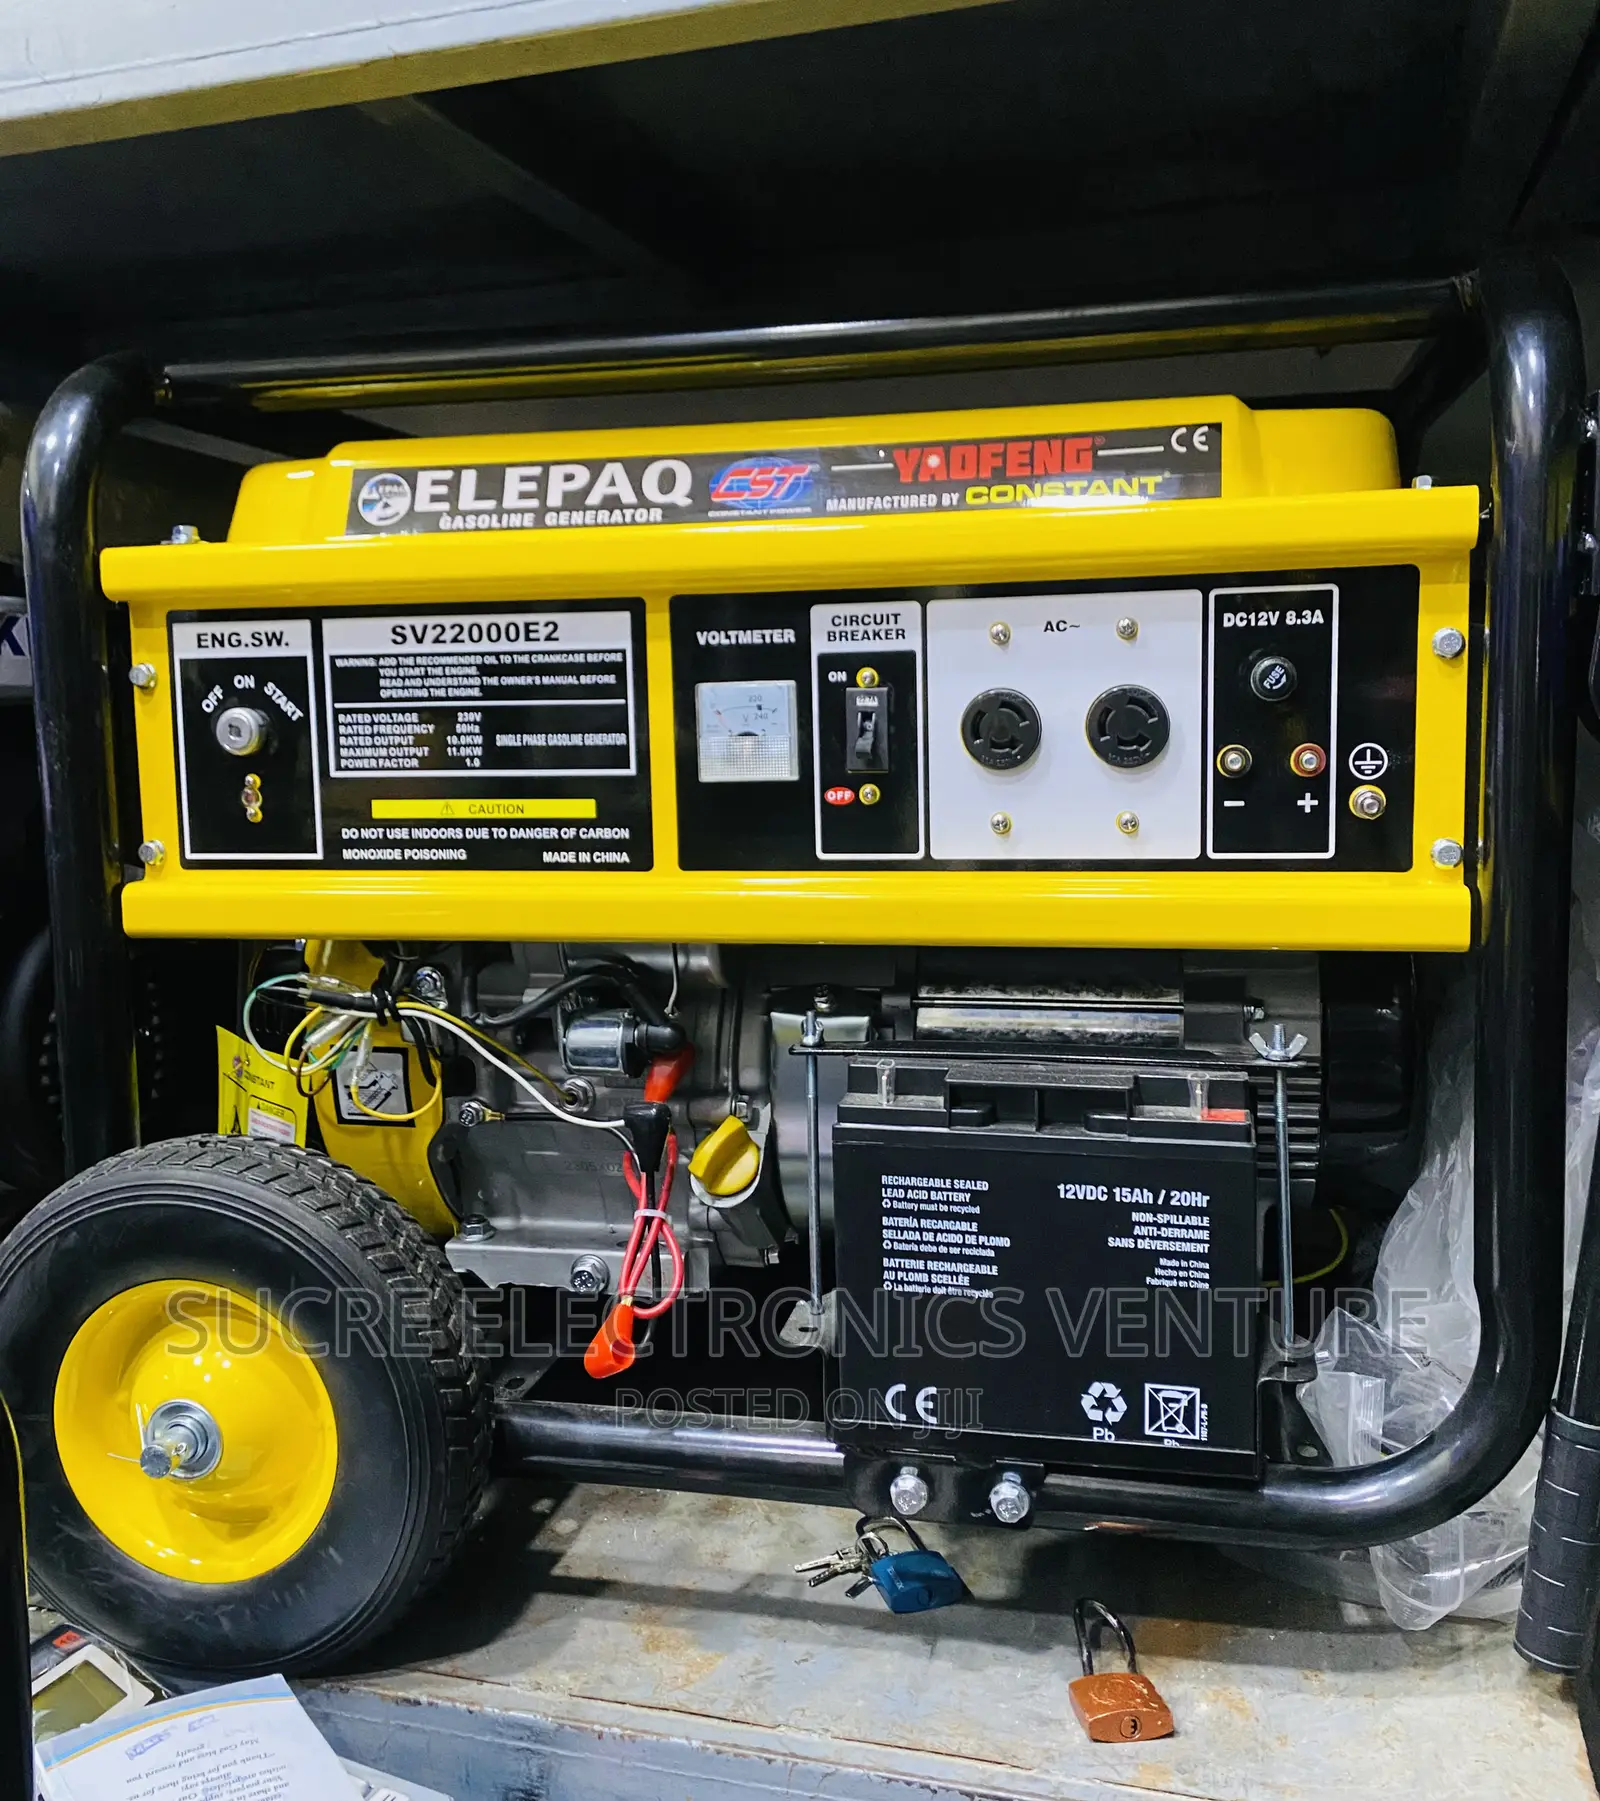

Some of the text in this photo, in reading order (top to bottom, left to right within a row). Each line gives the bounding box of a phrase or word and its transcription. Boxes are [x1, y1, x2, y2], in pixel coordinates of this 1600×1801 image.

[1171, 426, 1210, 454] CE
[892, 437, 1093, 483] YAOFENG
[414, 458, 693, 513] ELEPAQ
[710, 464, 810, 502] CST
[965, 474, 1164, 507] CONSTANT
[826, 490, 961, 513] MANUFACTURED BY
[439, 507, 663, 532] GASOLINE GENERATOR
[831, 613, 902, 628] CIRCUIT
[1222, 611, 1324, 628] DC12V 8.3A
[196, 631, 290, 650] ENG.SW.
[391, 621, 560, 646] SV22000E2
[696, 628, 796, 647] VOLTMETER
[827, 628, 906, 643] BREAKER
[379, 657, 397, 667] ADD
[398, 656, 415, 666] THE
[483, 655, 499, 665] OIL
[499, 654, 512, 664] TO
[513, 653, 530, 664] THE
[531, 653, 586, 664] CRANKCASE
[587, 652, 623, 663] BEFORE
[379, 666, 480, 677] YOU START THE ENGINE.
[828, 671, 848, 682] ON
[1263, 666, 1286, 690] FUSE
[234, 674, 256, 692] ON
[380, 674, 617, 688] READ AND UNDERSTAND THE OWNER'S MANUAL BEFORE
[202, 685, 224, 714] OFF
[380, 687, 483, 698] OPERATING THE ENGINE.
[263, 682, 304, 724] START
[338, 713, 372, 723] RATED
[372, 712, 419, 723] VOLTAGE
[339, 724, 435, 735] RATED FREQUENCY
[339, 735, 483, 746] RATED OUTPUT 10.0KW
[496, 733, 627, 747] SINGLE PHASE GASOLINE GENERATOR
[340, 746, 483, 757] MAXIMUM OUTPUT 11.0KW
[340, 757, 481, 769] POWER FACTOR 1.0
[827, 790, 851, 801] OFF
[468, 802, 525, 816] CAUTION
[342, 827, 630, 840] DO NOT USE INDOORS DUE TO DANGER OF CARBON
[343, 848, 467, 861] MONOXIDE POISONING
[543, 851, 630, 863] MADE IN CHINA
[881, 1174, 990, 1191] RECHARGEABLE SEALED
[881, 1187, 972, 1203] LEAD ACID BATTERY
[1057, 1183, 1210, 1208] 12VDC 15Ah / 20Hr
[892, 1200, 981, 1215] Battery must be recycled
[882, 1216, 979, 1232] BATERÍA RECARGABLE
[1131, 1211, 1210, 1227] NON-SPILLABLE
[882, 1229, 1011, 1248] SELLADA DE ACIDO DE PLOMO
[1133, 1225, 1210, 1241] ANTI-DERRAME
[920, 1243, 938, 1254] debe
[938, 1245, 948, 1254] de
[949, 1247, 961, 1255] ser
[962, 1247, 995, 1258] reciclada
[1107, 1236, 1210, 1254] SANS DÉVERSEMENT
[882, 1257, 999, 1276] BATTERIE RECHARGEABLE
[1159, 1257, 1210, 1269] Made in China
[883, 1270, 970, 1287] AU PLOMB SCELLÉE
[1154, 1267, 1210, 1280] Hecho en China
[893, 1283, 903, 1292] La
[904, 1283, 932, 1294] batterie
[932, 1285, 947, 1296] doit
[947, 1286, 962, 1296] être
[1145, 1276, 1210, 1290] Fabriqué en Chine
[885, 1382, 938, 1426] CE
[1093, 1427, 1116, 1441] Pb
